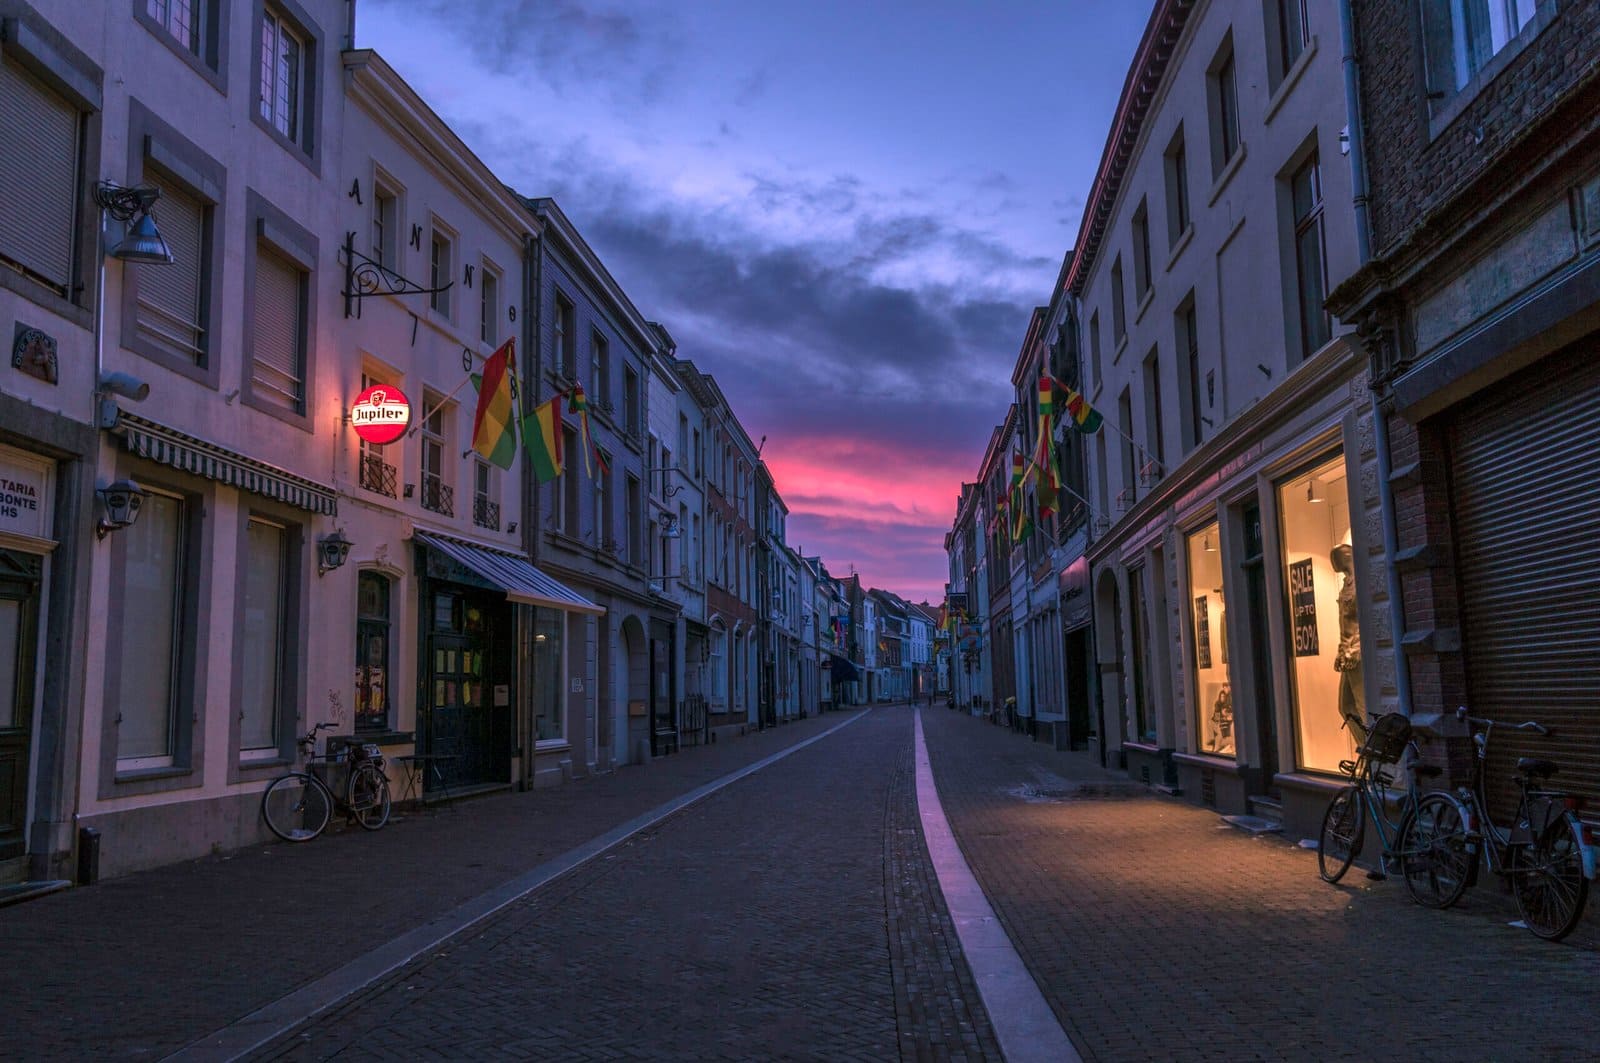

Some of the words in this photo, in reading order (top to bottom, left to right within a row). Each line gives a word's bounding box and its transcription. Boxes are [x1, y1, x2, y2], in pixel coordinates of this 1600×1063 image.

[355, 407, 403, 422] Jupiler
[0, 478, 36, 497] TARIA
[1291, 564, 1314, 596] SALE
[1294, 605, 1305, 617] UP
[1305, 603, 1315, 616] TO
[1296, 624, 1318, 652] 50%
